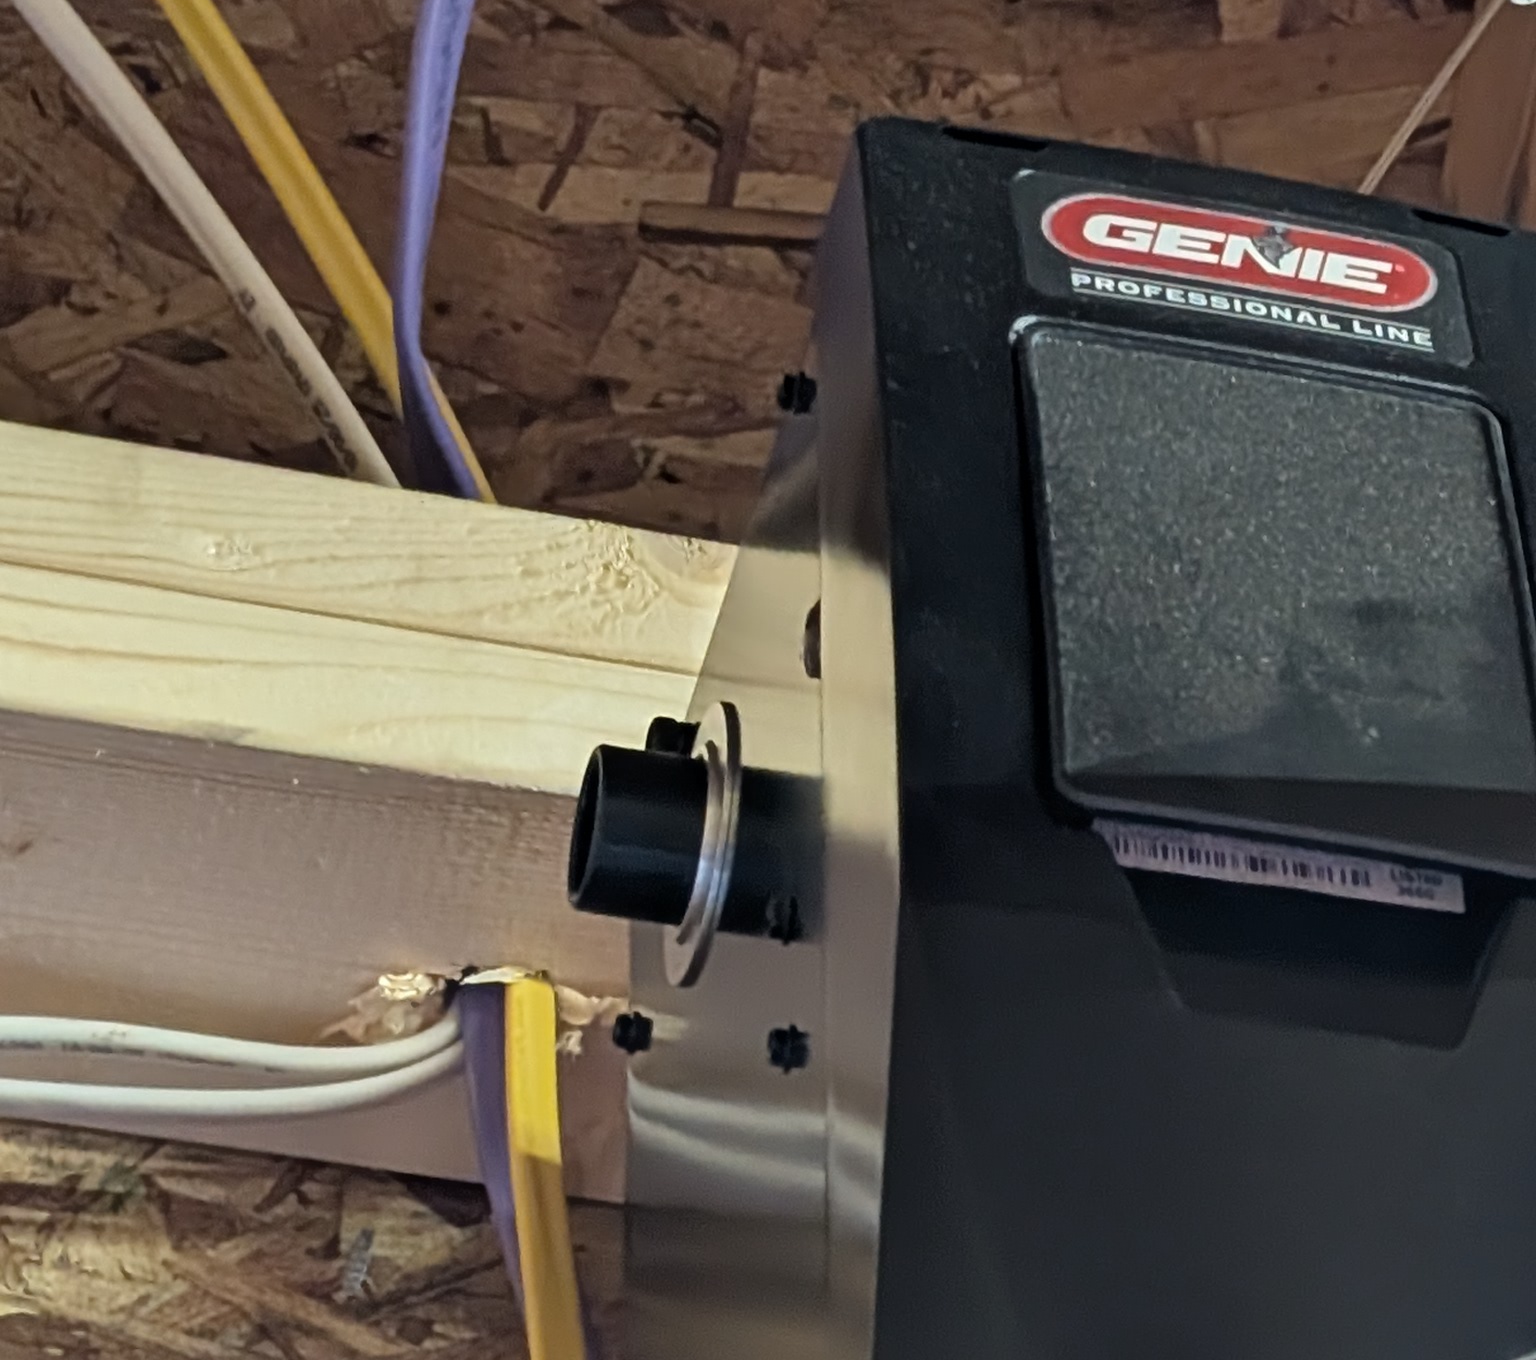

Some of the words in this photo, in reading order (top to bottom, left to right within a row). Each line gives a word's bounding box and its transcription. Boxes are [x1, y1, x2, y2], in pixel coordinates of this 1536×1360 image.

[1083, 213, 1393, 294] GENIE
[1071, 272, 1341, 331] PROFESSIONAL
[1352, 319, 1434, 347] LINE
